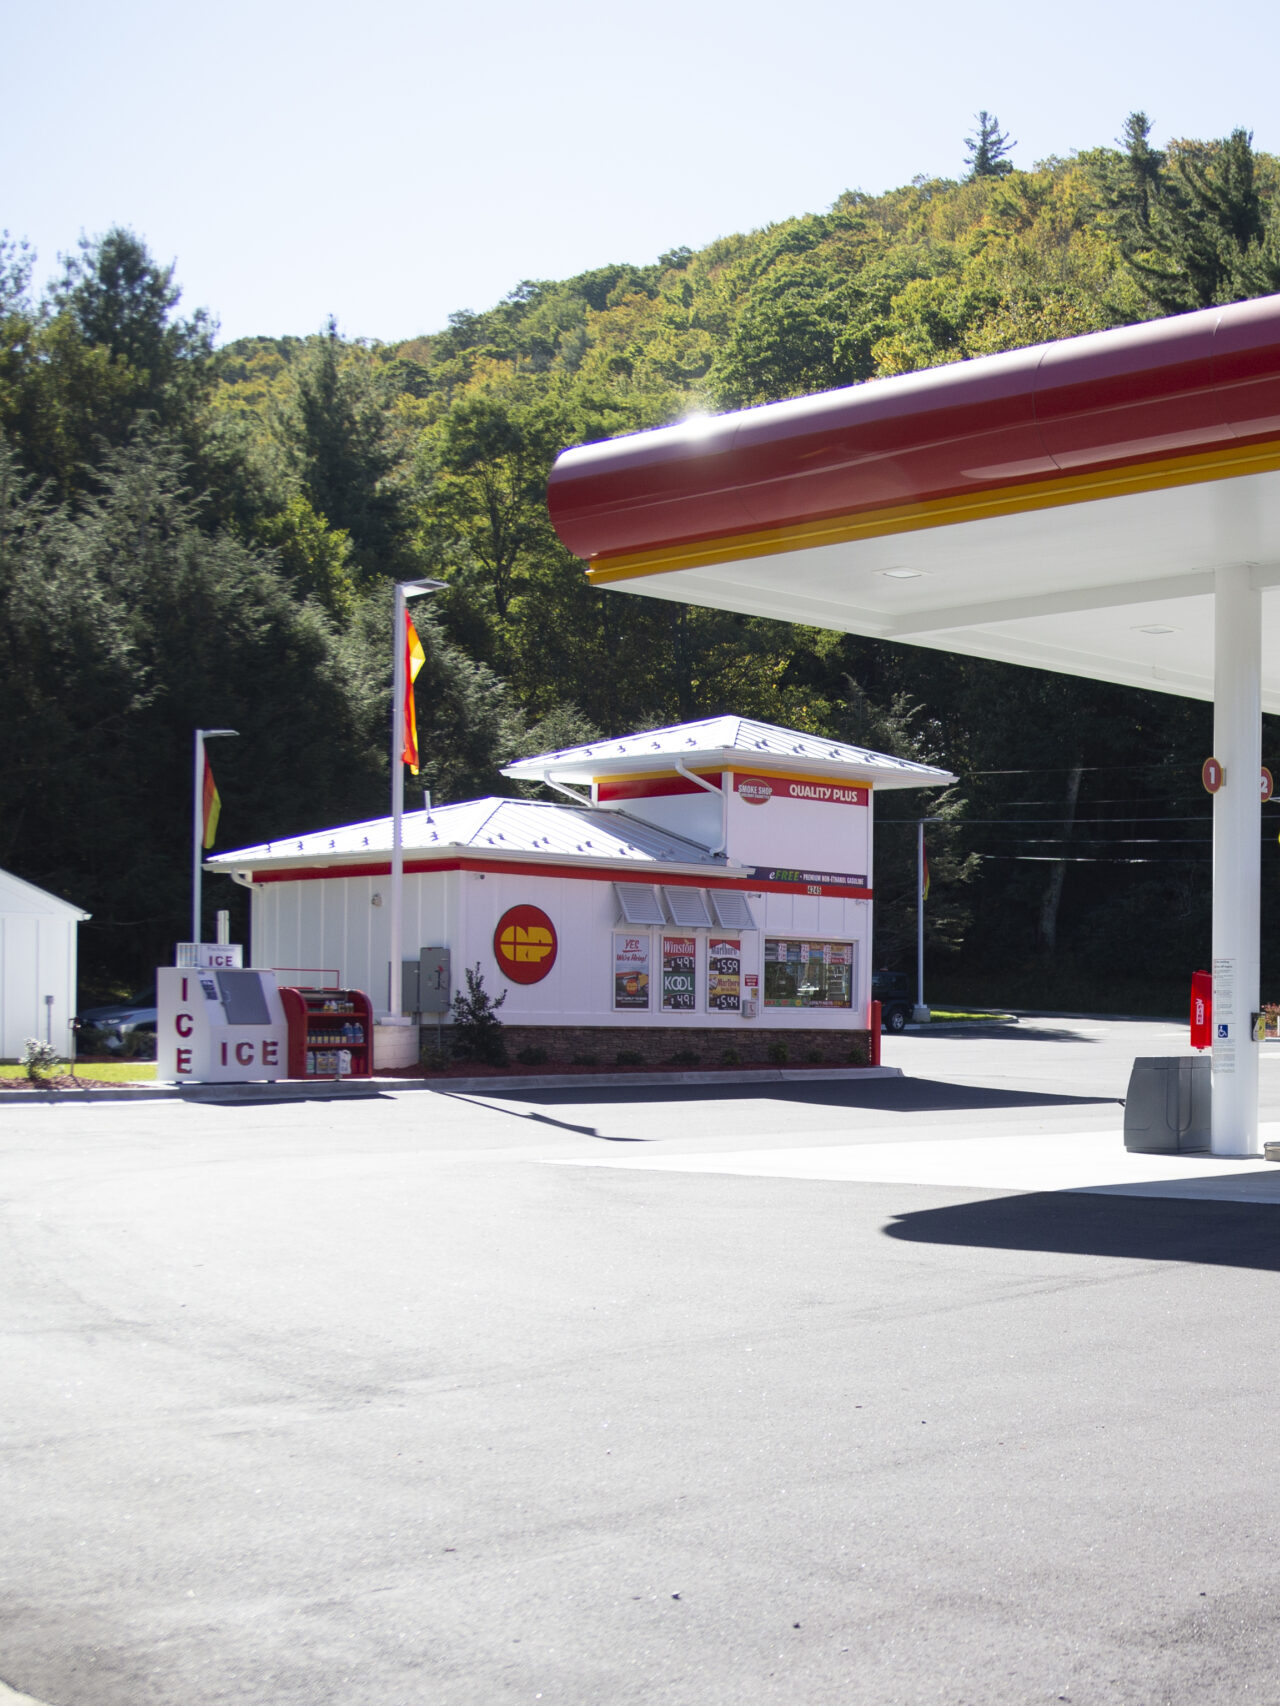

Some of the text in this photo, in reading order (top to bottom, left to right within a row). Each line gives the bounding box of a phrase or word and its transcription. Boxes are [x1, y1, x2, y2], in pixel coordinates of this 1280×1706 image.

[1209, 767, 1215, 784] 1
[739, 784, 772, 795] SMOKE SHOP
[1261, 776, 1268, 793] 2
[789, 784, 858, 802] QUALITY PLUS
[769, 870, 800, 881] eFREE
[624, 940, 640, 949] YES
[664, 940, 694, 954] Winston
[711, 942, 738, 955] Marlboro
[208, 956, 233, 966] ICE
[664, 976, 692, 990] KOOL
[175, 977, 194, 1074] ICE
[221, 1040, 279, 1066] ICE
